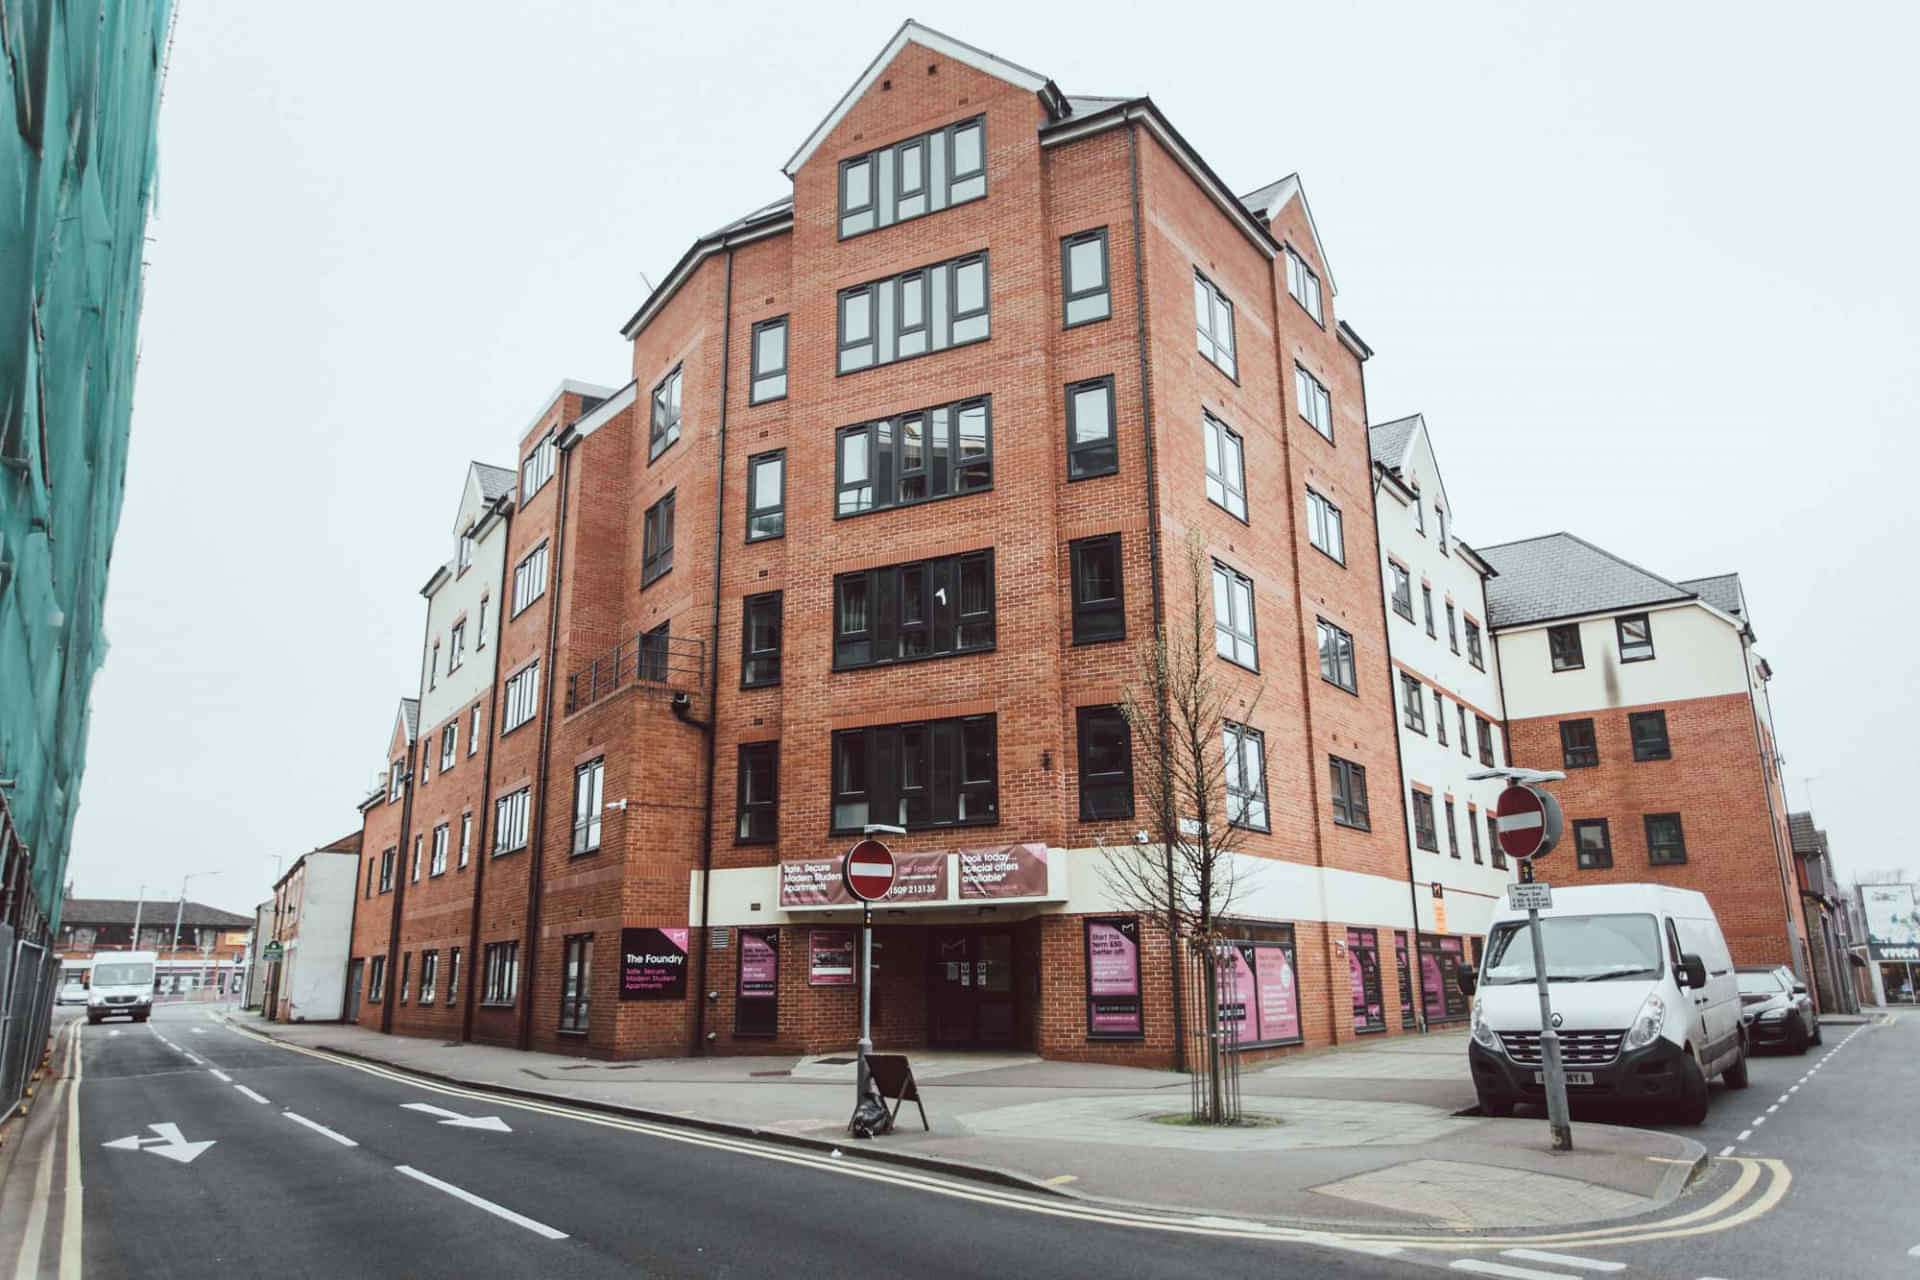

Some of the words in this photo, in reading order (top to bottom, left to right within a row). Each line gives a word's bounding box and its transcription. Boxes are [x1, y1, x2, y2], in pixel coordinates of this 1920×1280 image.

[814, 872, 843, 881] Studen
[627, 953, 643, 964] The
[646, 953, 684, 965] Foundry
